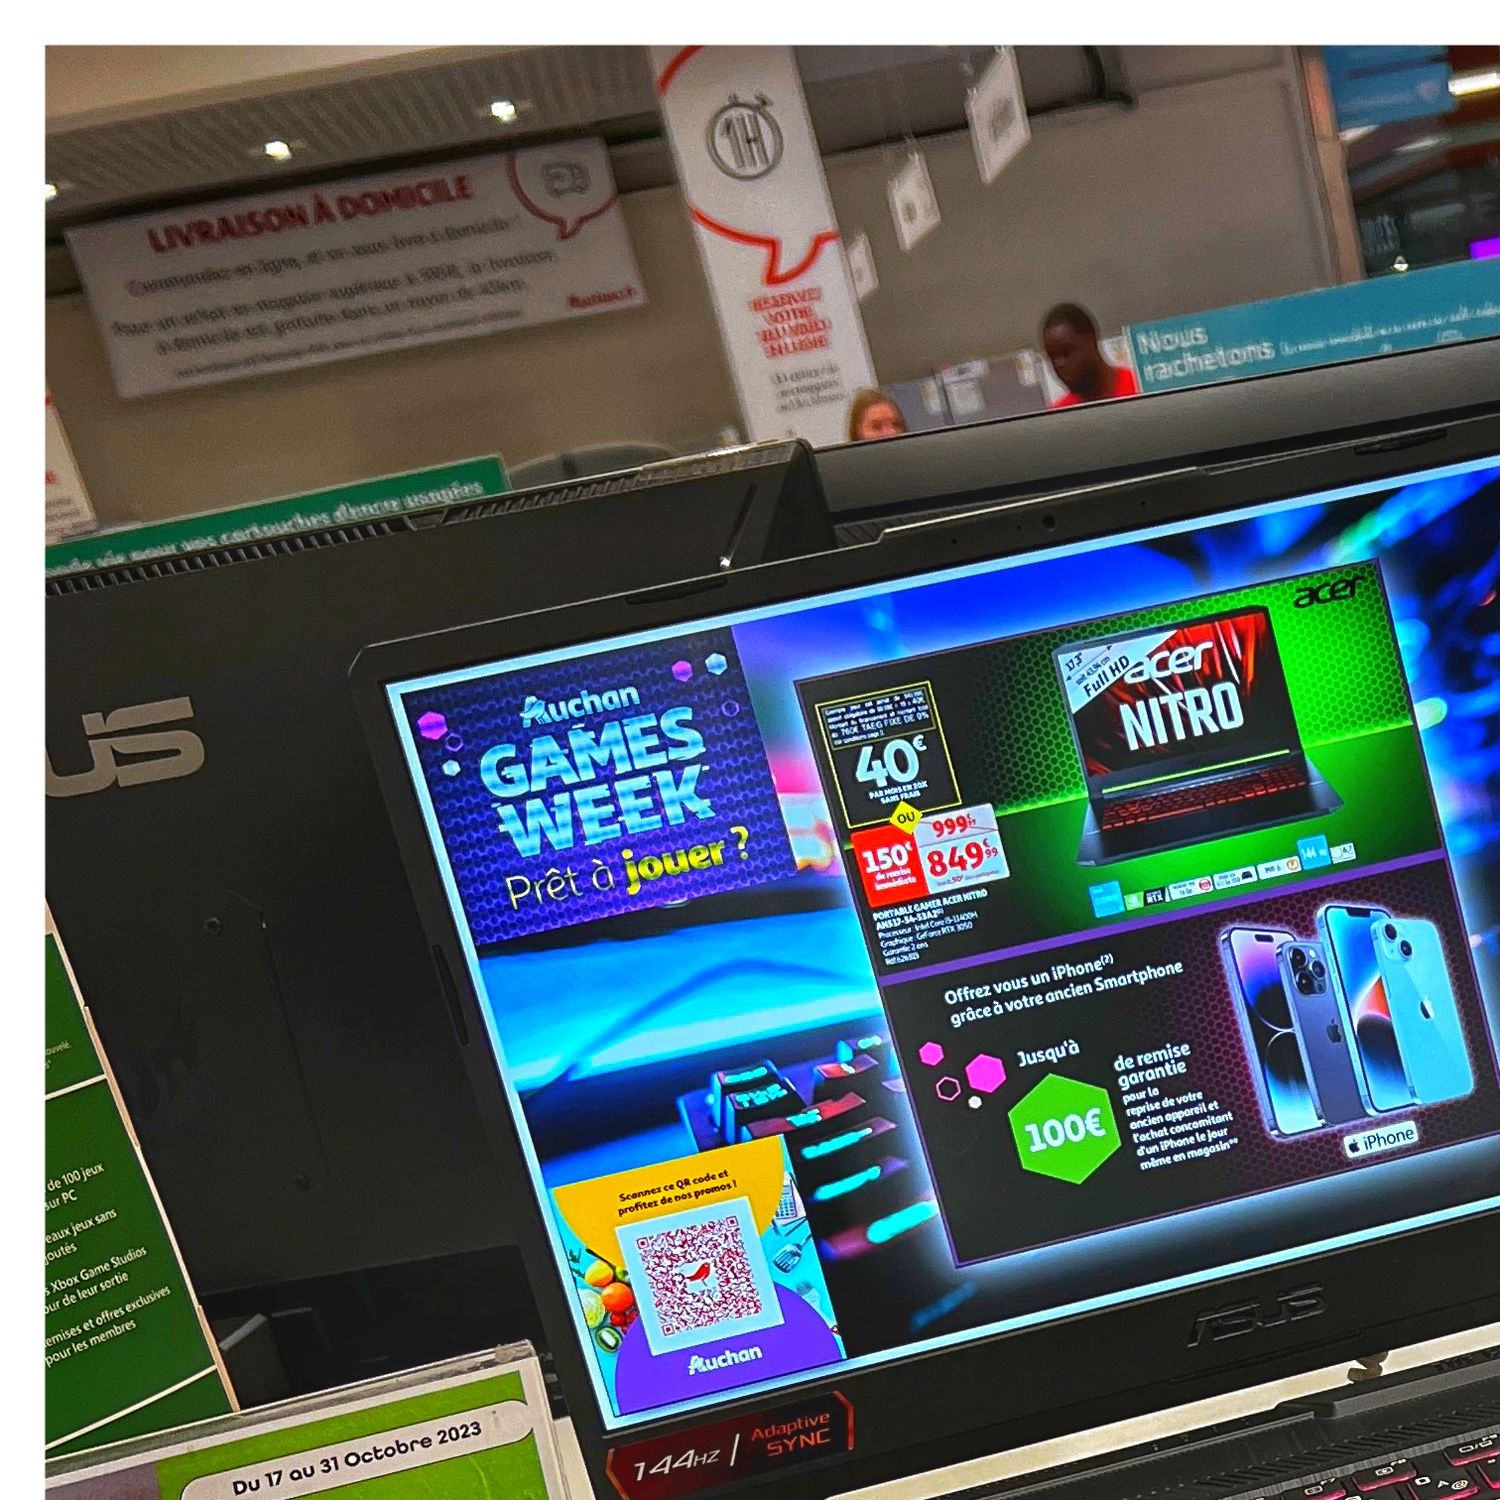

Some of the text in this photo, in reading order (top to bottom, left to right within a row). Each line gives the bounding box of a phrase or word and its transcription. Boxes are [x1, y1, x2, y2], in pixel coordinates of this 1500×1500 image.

[1138, 324, 1209, 354] Nous
[1144, 337, 1274, 381] rachetons
[219, 506, 330, 546] cartouches
[1293, 576, 1366, 609] acer
[1083, 654, 1130, 699] Full HD
[1123, 641, 1213, 684] acer
[520, 686, 640, 728] Auchan
[1119, 681, 1244, 751] NITRO
[480, 706, 706, 797] GAMES
[498, 764, 716, 858] WEEK
[505, 838, 726, 910] Prêt jouer
[873, 889, 988, 920] PORTABLE GAMER ACER NITRO
[944, 982, 990, 1005] Offrez
[992, 975, 1024, 995] vous
[950, 959, 1184, 1028] grâce votre ancien Smartphone
[1016, 1040, 1081, 1069] Jusqu'à
[1113, 1042, 1192, 1072] de remise
[1118, 1060, 1187, 1091] garantie
[1024, 1107, 1107, 1153] 100€
[1170, 1110, 1234, 1136] concomitant
[1363, 1126, 1416, 1148] iPhone
[618, 1182, 731, 1216] profitez nos promos
[619, 1174, 717, 1203] Scannez QR code
[51, 1246, 147, 1293] Xbox Game Studios
[96, 1286, 171, 1326] offres exclusives
[688, 1345, 763, 1375] Auchan
[344, 1420, 482, 1468] Octobre 2023
[752, 1412, 830, 1441] Adaptive
[766, 1428, 831, 1457] SYNC
